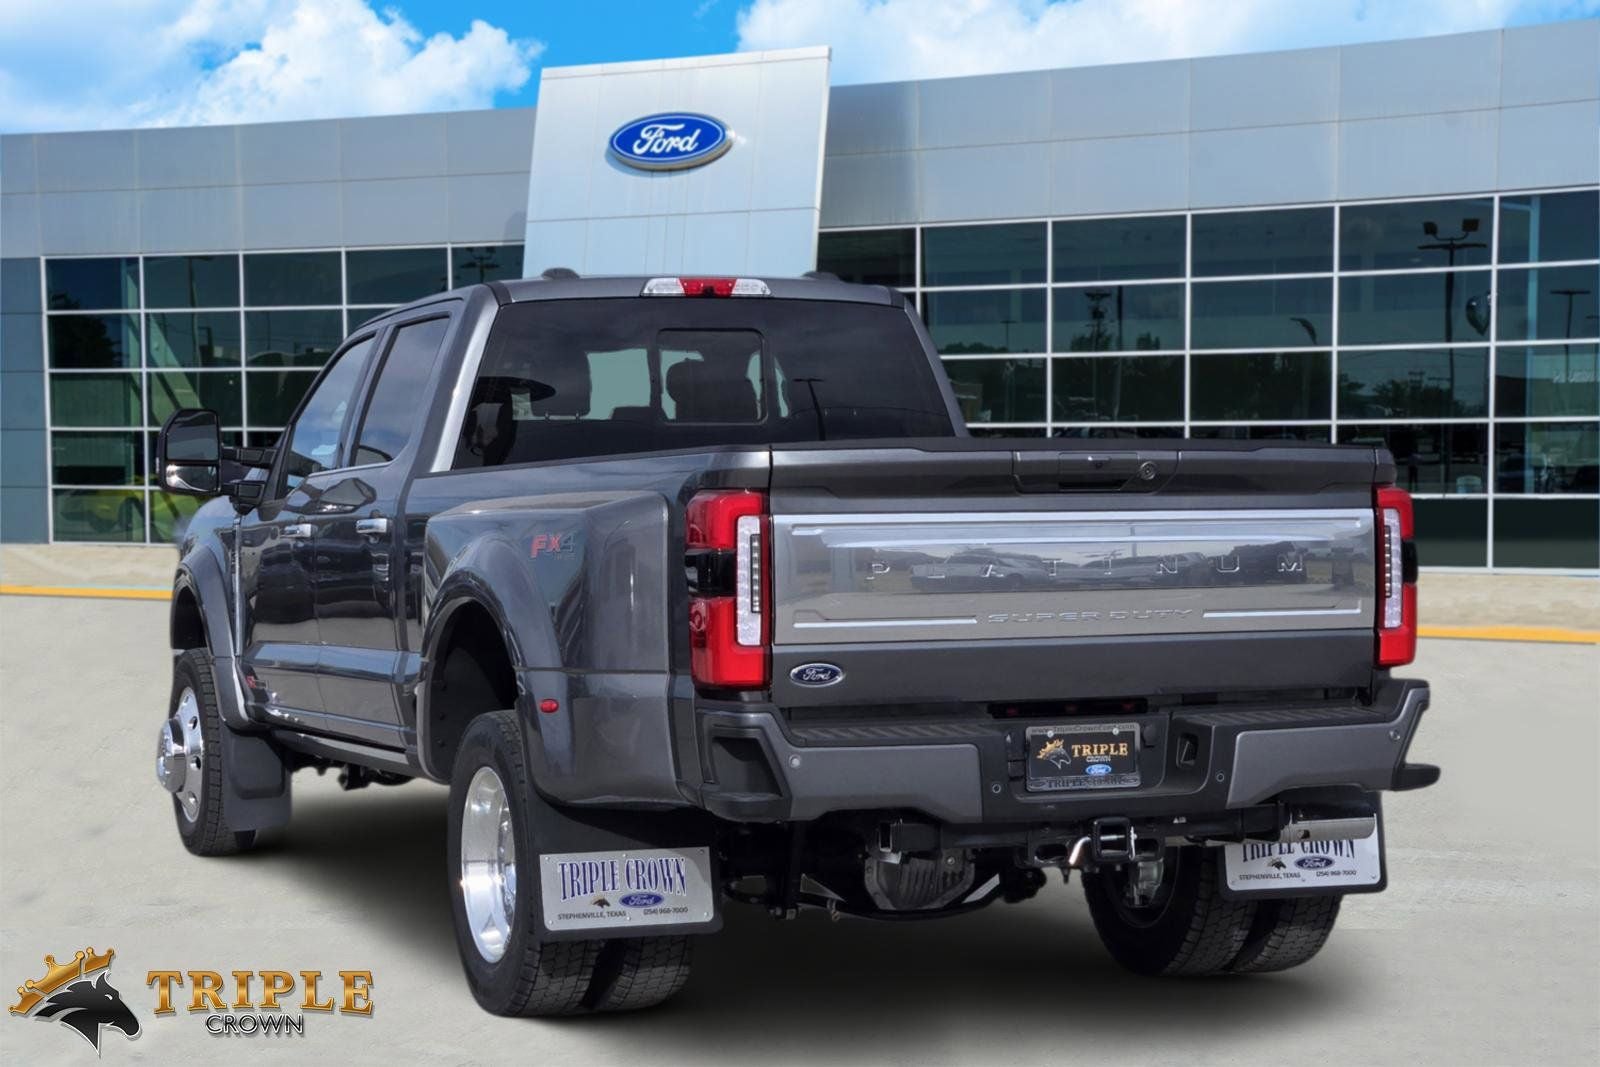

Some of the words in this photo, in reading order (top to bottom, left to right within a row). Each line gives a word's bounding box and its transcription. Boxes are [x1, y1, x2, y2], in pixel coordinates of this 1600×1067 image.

[633, 123, 702, 155] Ford
[531, 534, 575, 559] FX4
[866, 555, 1303, 579] PLATINUM
[988, 611, 1100, 623] SUPER
[1110, 609, 1192, 619] DUTY
[802, 667, 831, 681] Ford
[1071, 743, 1128, 757] TRIPLE
[558, 860, 620, 901] TRIPLE
[625, 858, 687, 896] CROWN
[558, 910, 606, 920] STEPHENVILLE,
[607, 910, 626, 918] TEXAS
